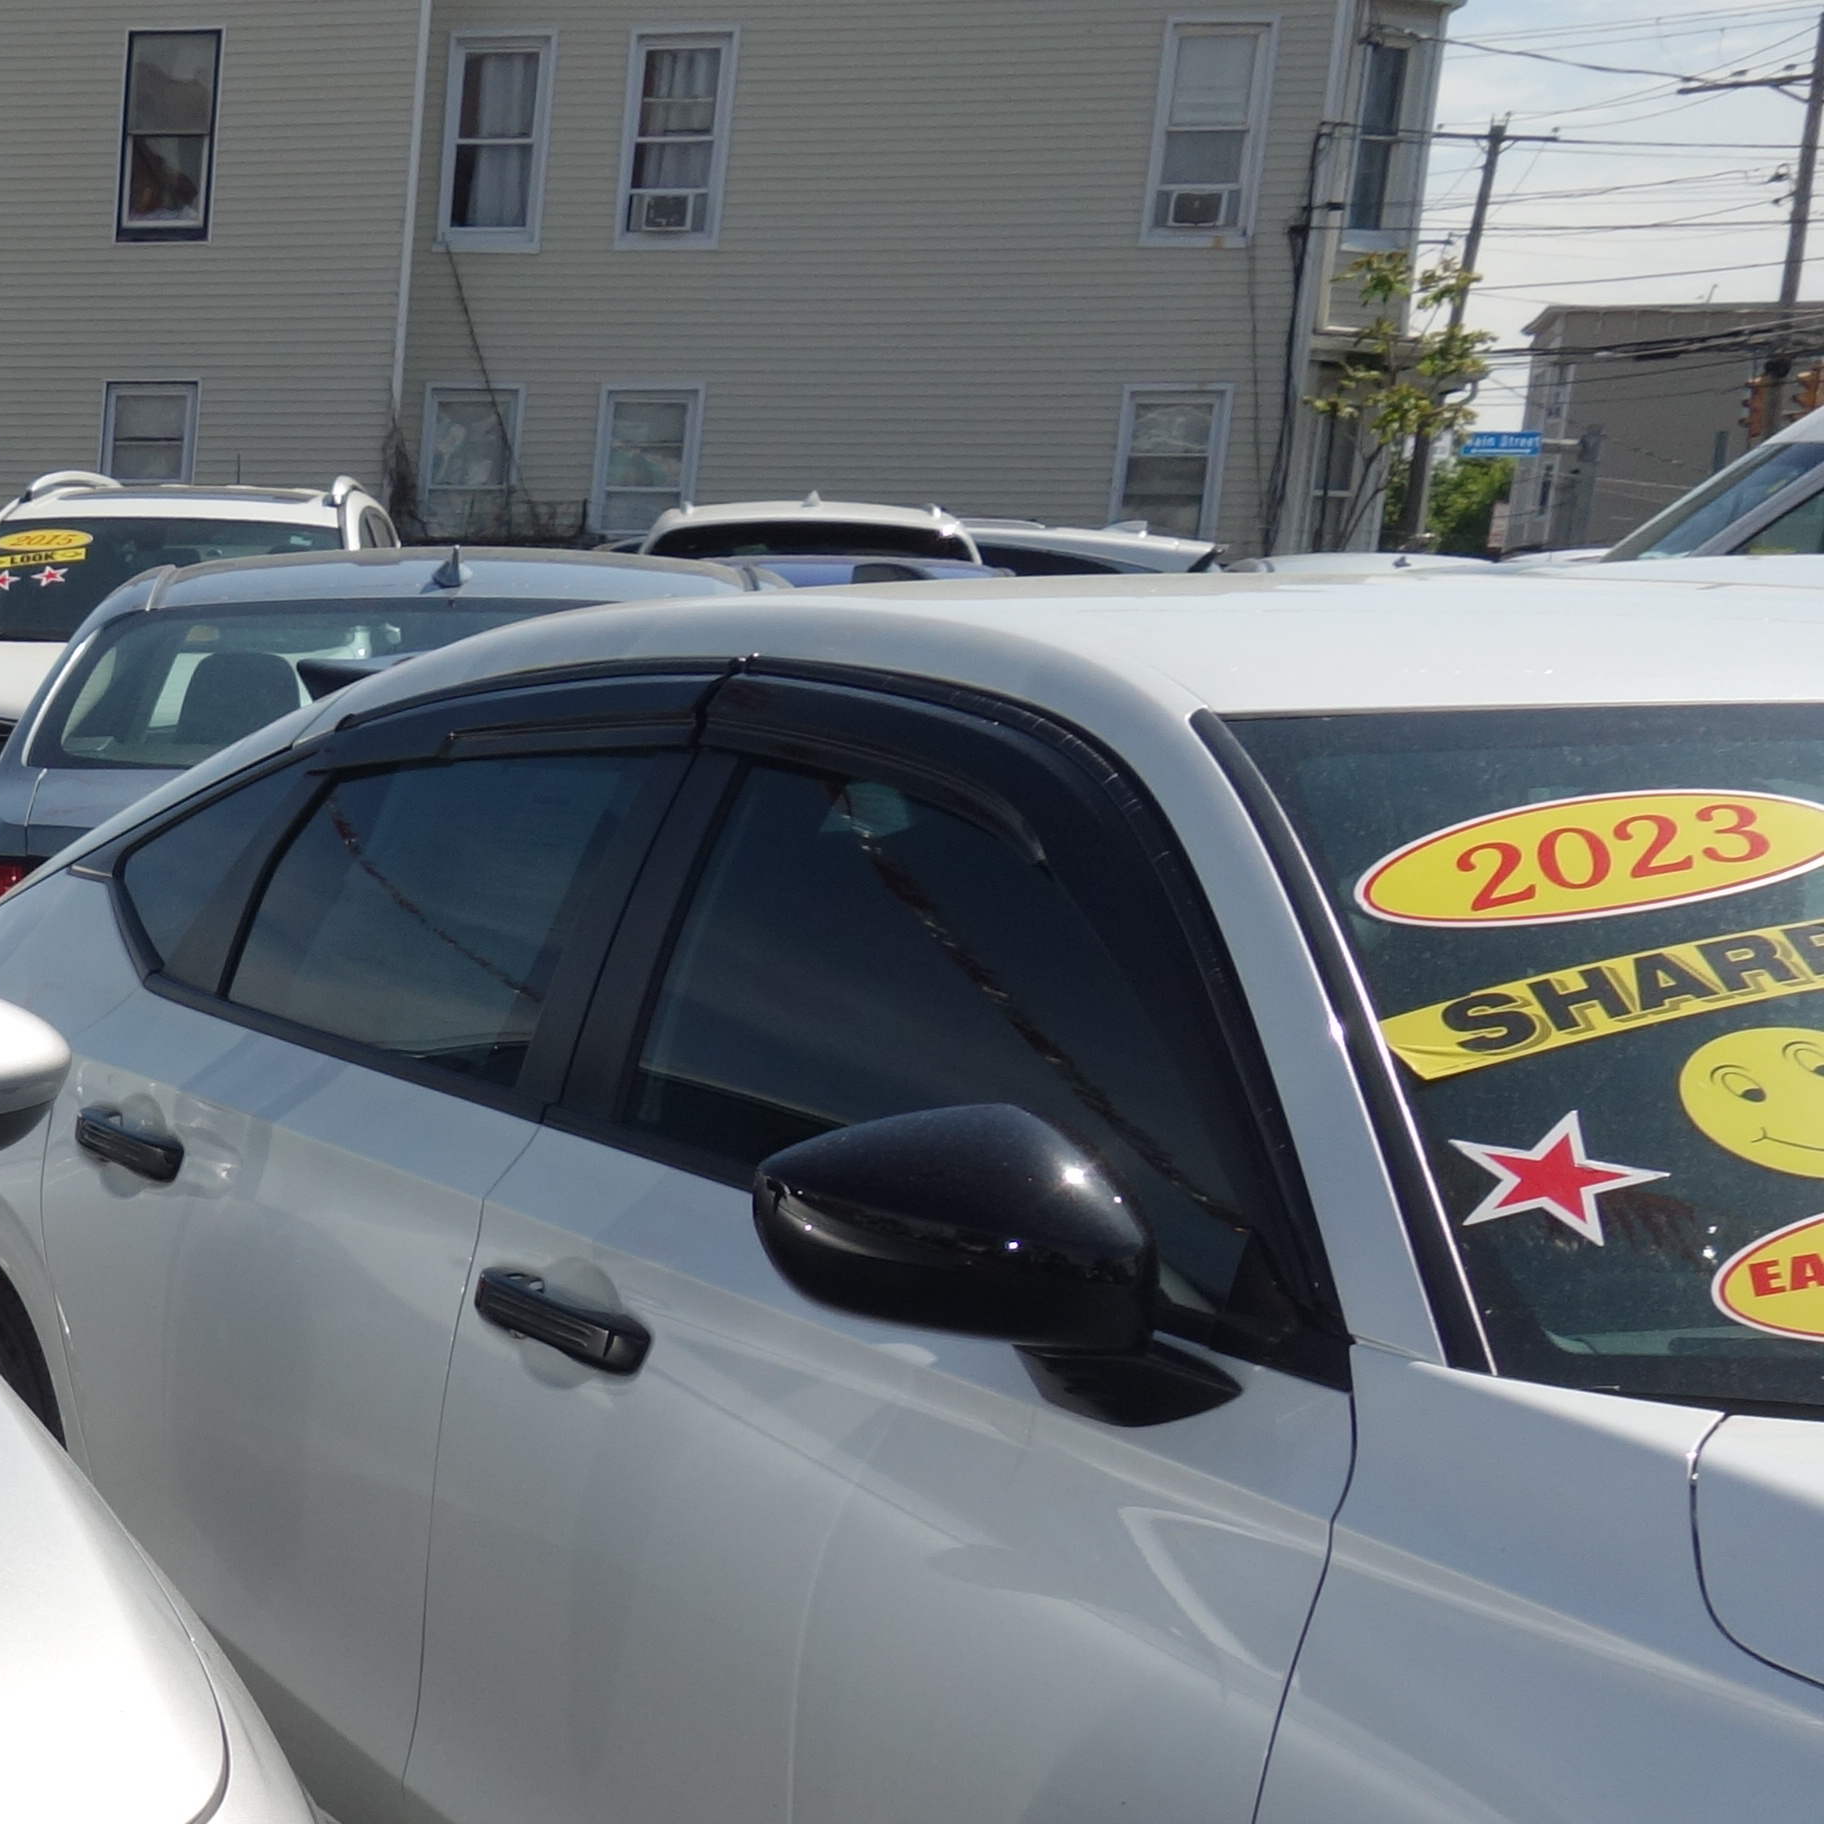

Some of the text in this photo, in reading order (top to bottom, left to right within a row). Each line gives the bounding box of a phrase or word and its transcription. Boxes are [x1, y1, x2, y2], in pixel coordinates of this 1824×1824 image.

[1499, 434, 1540, 448] Street
[9, 534, 78, 547] 2015
[9, 551, 56, 565] LOOK
[1455, 803, 1770, 912] 2023
